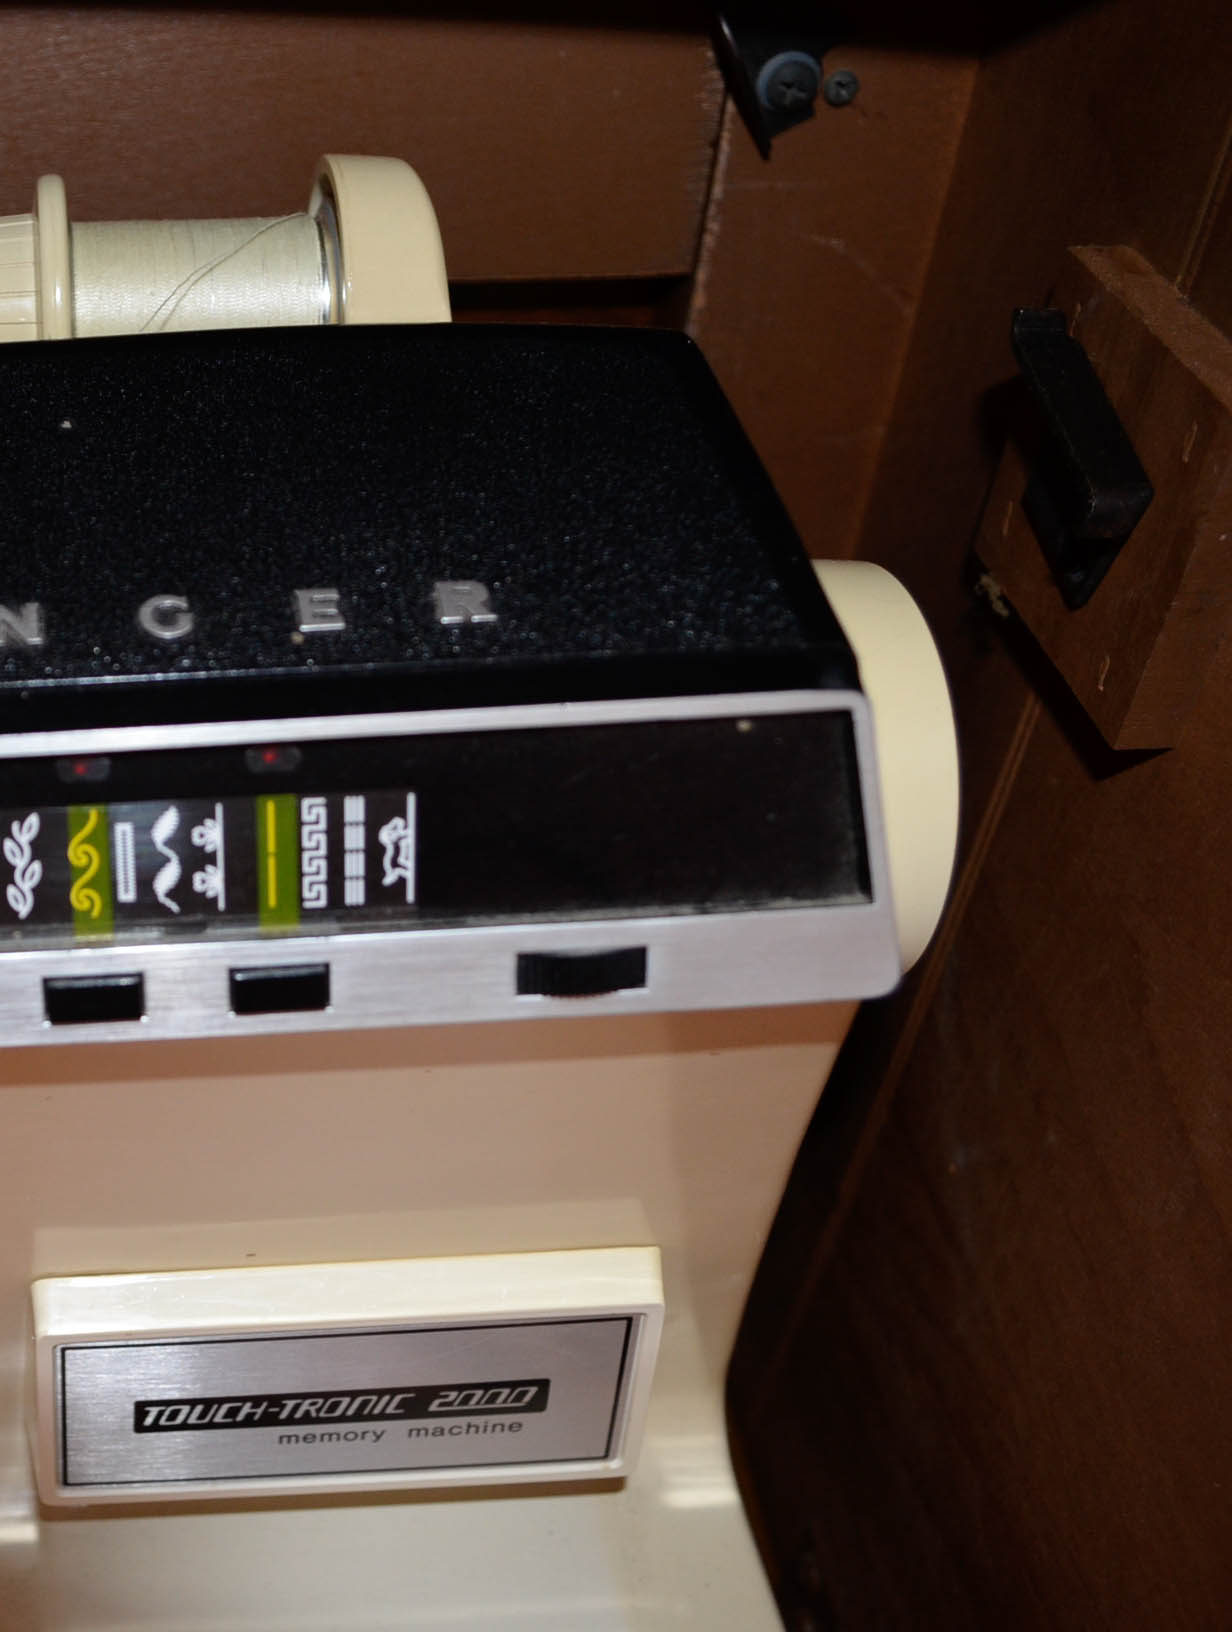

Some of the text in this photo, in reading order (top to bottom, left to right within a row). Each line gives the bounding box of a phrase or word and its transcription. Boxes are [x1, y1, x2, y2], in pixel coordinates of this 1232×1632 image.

[142, 1386, 539, 1427] TOUCH-TRONIC 2000
[278, 1420, 524, 1445] memory machine
